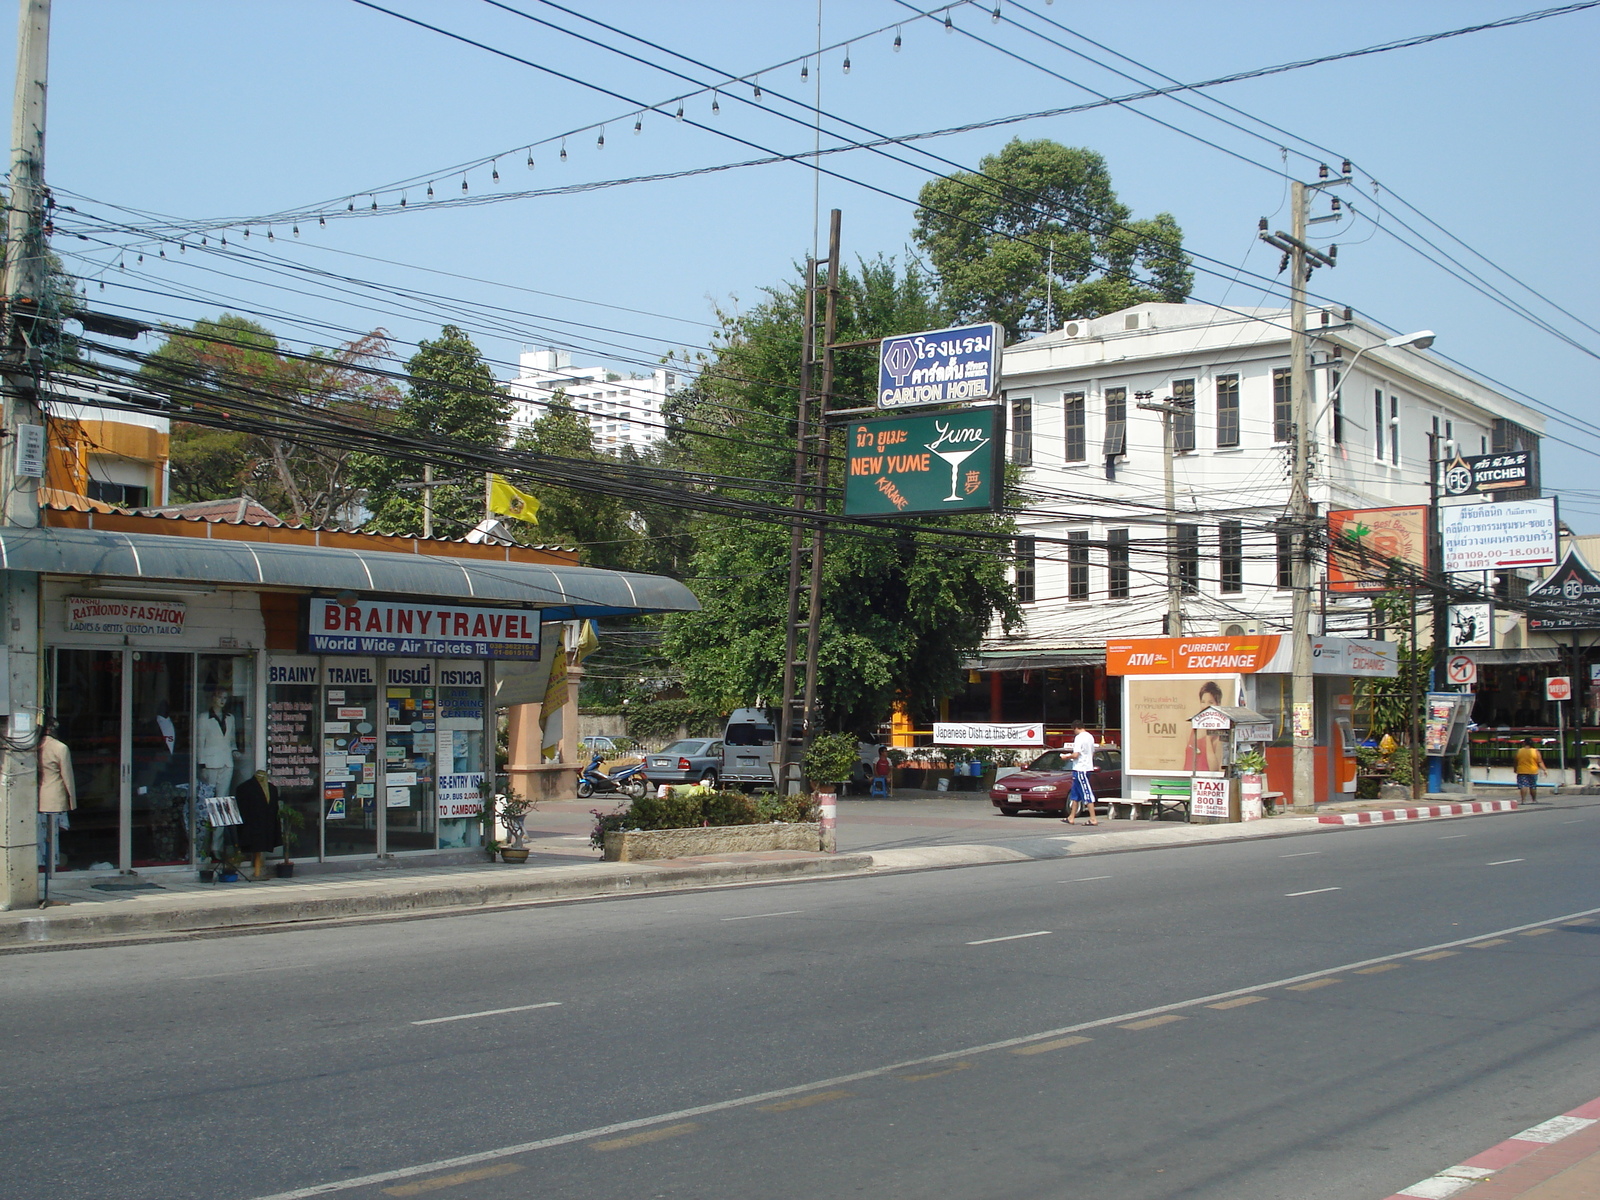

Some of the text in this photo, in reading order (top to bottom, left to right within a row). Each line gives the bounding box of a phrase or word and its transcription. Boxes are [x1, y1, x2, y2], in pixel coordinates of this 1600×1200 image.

[914, 335, 991, 360] โรงแรม
[881, 378, 988, 406] CARLTON HOTEL
[856, 425, 908, 453] นิว ยูเมะ
[931, 419, 984, 449] Yume
[851, 453, 931, 476] NEW YUME
[1475, 466, 1526, 482] KITCHEN
[874, 476, 909, 511] KARAOKE
[1373, 519, 1392, 530] Best
[1465, 558, 1490, 568] เมตร
[73, 604, 186, 625] RAYMOND'S FASHION
[70, 622, 94, 631] LADIES
[102, 623, 123, 632] GENTS
[125, 624, 154, 634] CUSTOM
[156, 625, 182, 634] TAILOR
[324, 605, 533, 639] BRAINY TRAVEL
[1542, 619, 1556, 632] Try
[315, 636, 356, 651] World
[361, 637, 396, 652] Wide
[400, 639, 421, 653] Air
[424, 640, 473, 655] Tickets
[475, 643, 489, 655] TEL
[1178, 643, 1231, 656] CURRENCY
[1127, 653, 1155, 667] ATM
[1187, 654, 1257, 669] EXCHANGE
[270, 666, 373, 683] BRAINY TRAVEL
[388, 663, 482, 685] เบรนนี่ ทราเวล
[451, 689, 469, 697] AIR
[438, 699, 484, 708] BOOKING
[440, 710, 481, 718] CENTRE
[1194, 711, 1228, 722] LIMOUSINE
[936, 725, 966, 740] Japanese
[968, 726, 983, 739] Dish
[985, 728, 992, 739] at
[993, 727, 1006, 739] this
[1146, 723, 1177, 735] I CAN
[1236, 727, 1253, 739] TAXI
[439, 775, 468, 789] RE-ENTRY
[1197, 781, 1224, 791] TAXI
[452, 792, 463, 800] BUS
[1197, 797, 1214, 805] 800
[439, 805, 448, 816] TO
